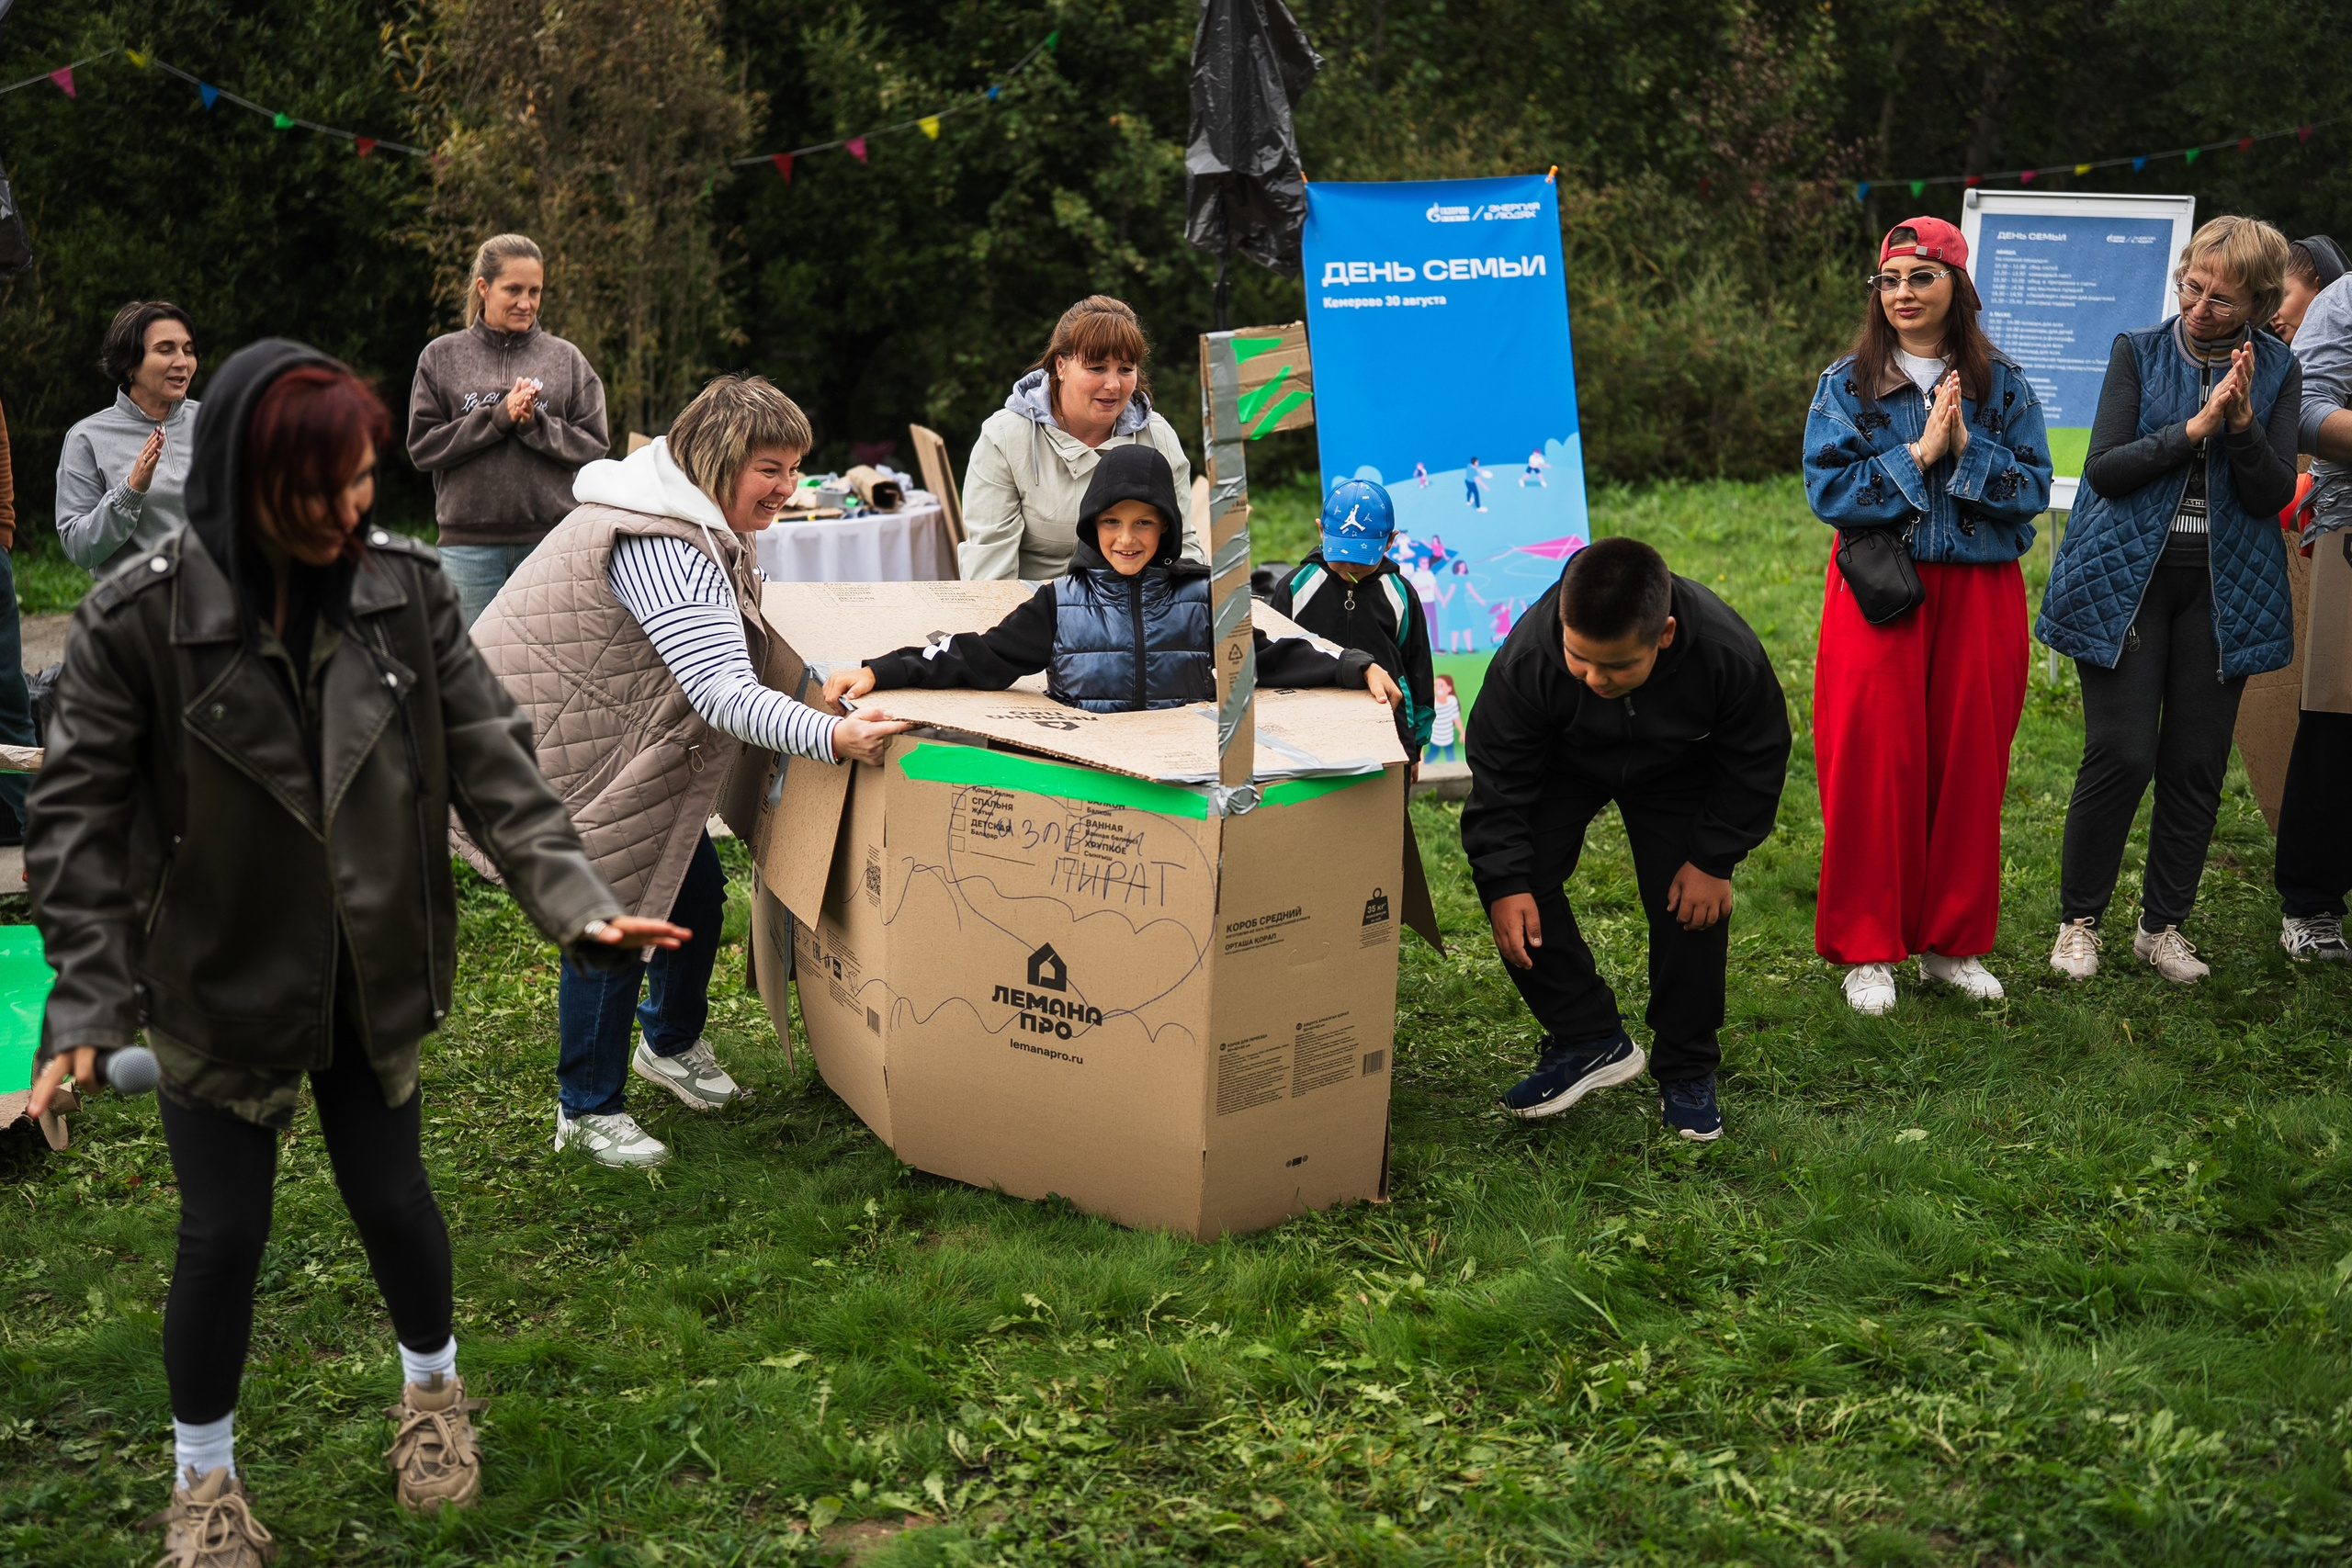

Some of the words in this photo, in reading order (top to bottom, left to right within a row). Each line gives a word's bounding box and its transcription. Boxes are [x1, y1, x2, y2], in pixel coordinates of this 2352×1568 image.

[1996, 231, 2028, 242] ДЕНЬ
[2028, 231, 2067, 242] СЕМЬИ
[1321, 261, 1417, 288] ДЕНЬ
[1422, 254, 1547, 282] СЕМЬИ
[1323, 297, 1383, 310] Кемерово
[1385, 295, 1401, 307] 30
[1402, 295, 1447, 309] августа
[971, 796, 1013, 811] СПАЛЬНЯ
[970, 818, 1012, 833] ДЕТСКАЯ
[1085, 819, 1124, 833] ВАННАЯ
[1085, 840, 1127, 855] ХРУПКОЕ
[1051, 857, 1187, 907] ПИРАТ
[1367, 905, 1376, 914] 35
[1226, 919, 1258, 933] КОРОБ
[1259, 906, 1302, 925] СРЕДНИЙ
[1225, 939, 1253, 951] ОРТАША
[1254, 933, 1277, 944] ҚОРАП
[991, 985, 1102, 1026] ЛЕМАНА
[1020, 1012, 1072, 1041] ПРО
[1010, 1038, 1084, 1066] lemanapro.ru
